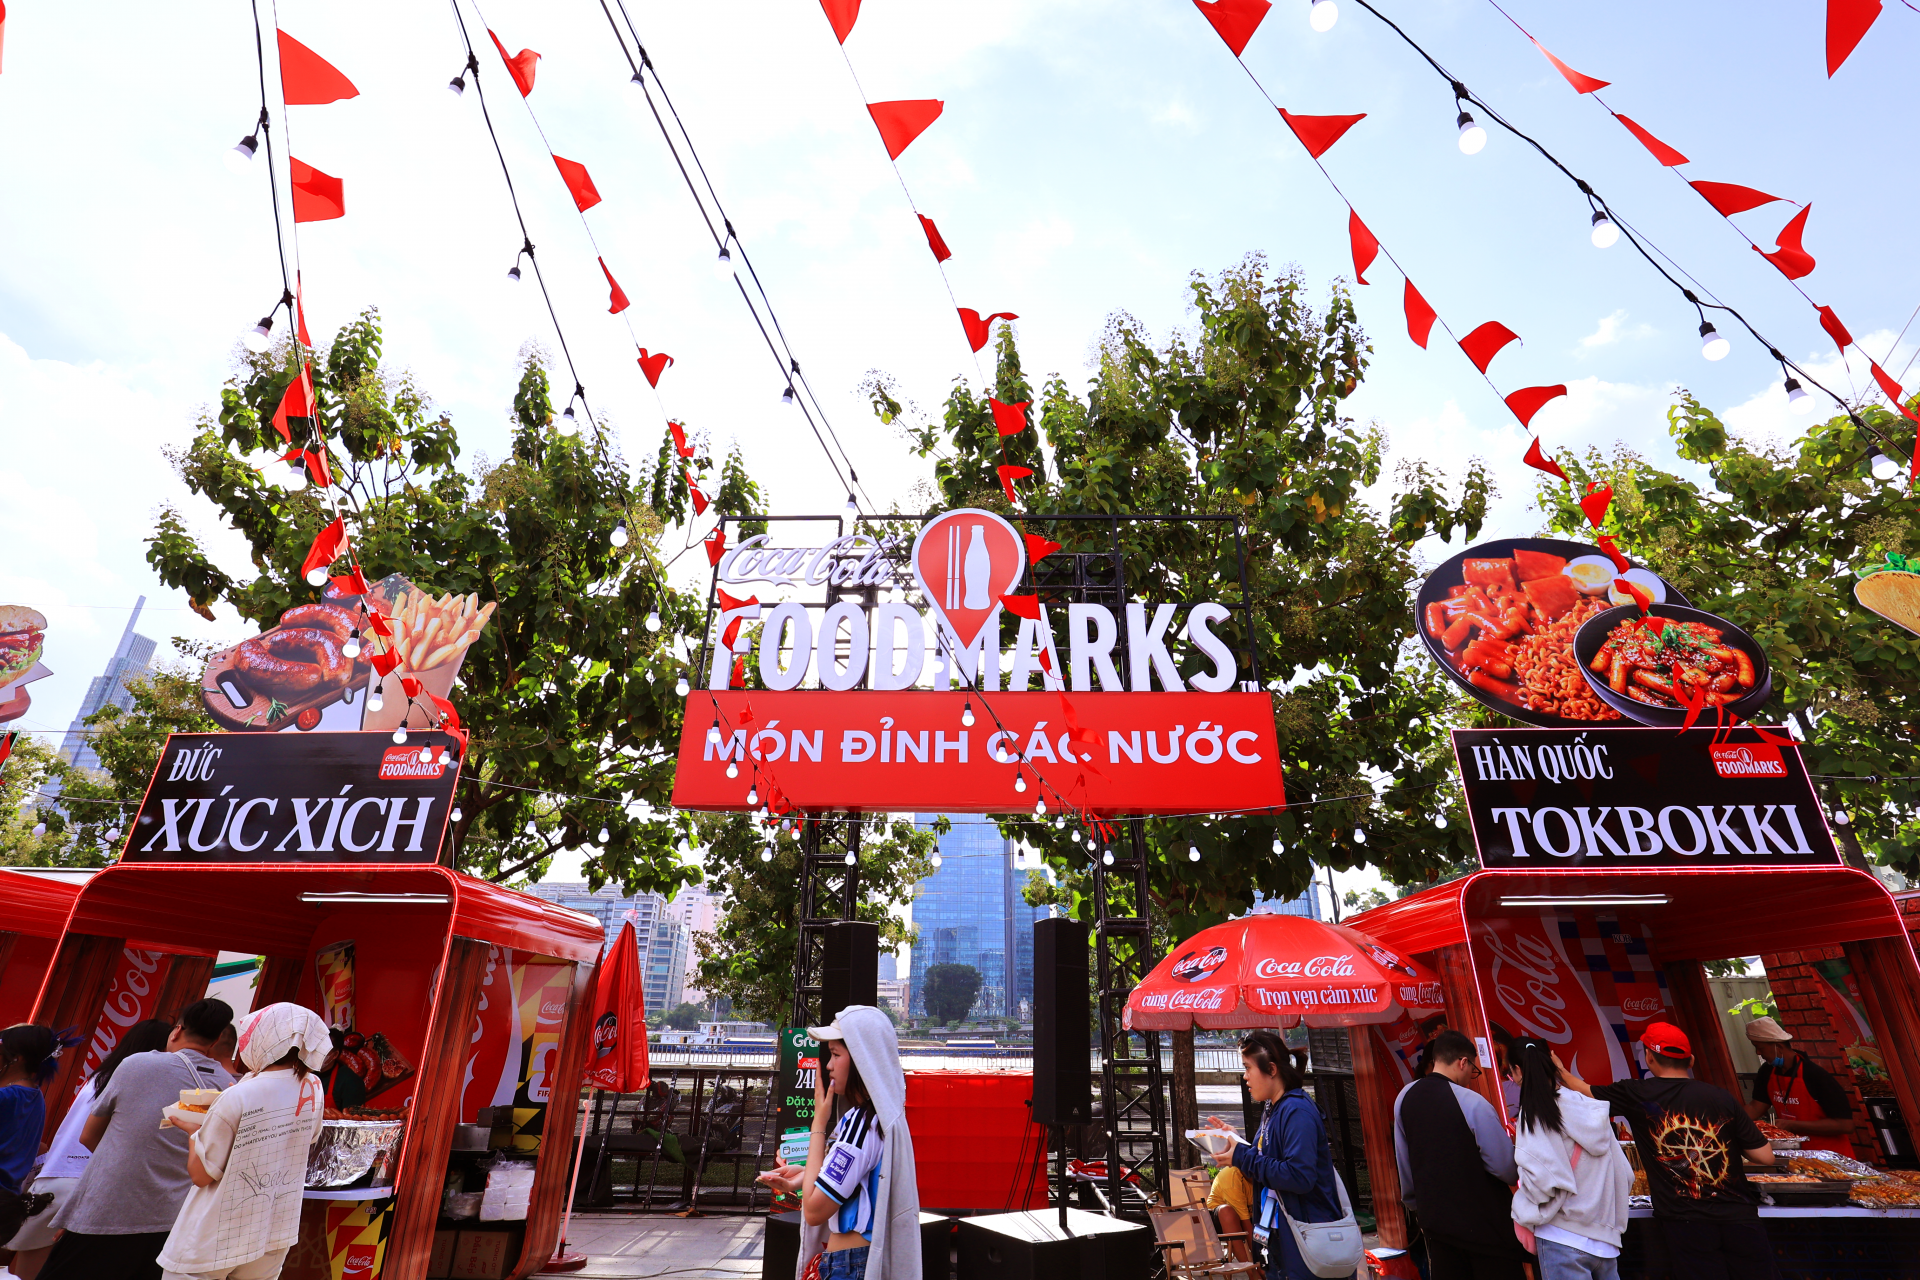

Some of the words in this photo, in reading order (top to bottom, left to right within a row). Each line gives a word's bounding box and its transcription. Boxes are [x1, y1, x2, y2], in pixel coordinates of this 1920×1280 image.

[720, 534, 908, 588] Coca-Cola
[709, 602, 1238, 692] FOODMARKS
[167, 741, 222, 782] ĐỨC
[703, 720, 824, 762] MÓN
[840, 716, 969, 763] ĐỈNH
[986, 721, 1093, 764] CÁC
[1108, 721, 1262, 764] NƯỚC
[1471, 738, 1536, 782] HÀN
[1537, 732, 1614, 784] QUỐC
[381, 763, 440, 776] FOODMARKS
[1716, 761, 1783, 775] FOODMARKS
[140, 785, 279, 852] XÚC
[273, 784, 436, 852] XÍCH
[1491, 804, 1815, 858] TOKBOKKI
[1256, 987, 1292, 1010] Trọn
[1292, 989, 1319, 1009] vẹn
[1320, 985, 1351, 1005] cảm
[1351, 984, 1378, 1004] xúc
[793, 1033, 820, 1047] Gra
[786, 1096, 806, 1108] Đặt
